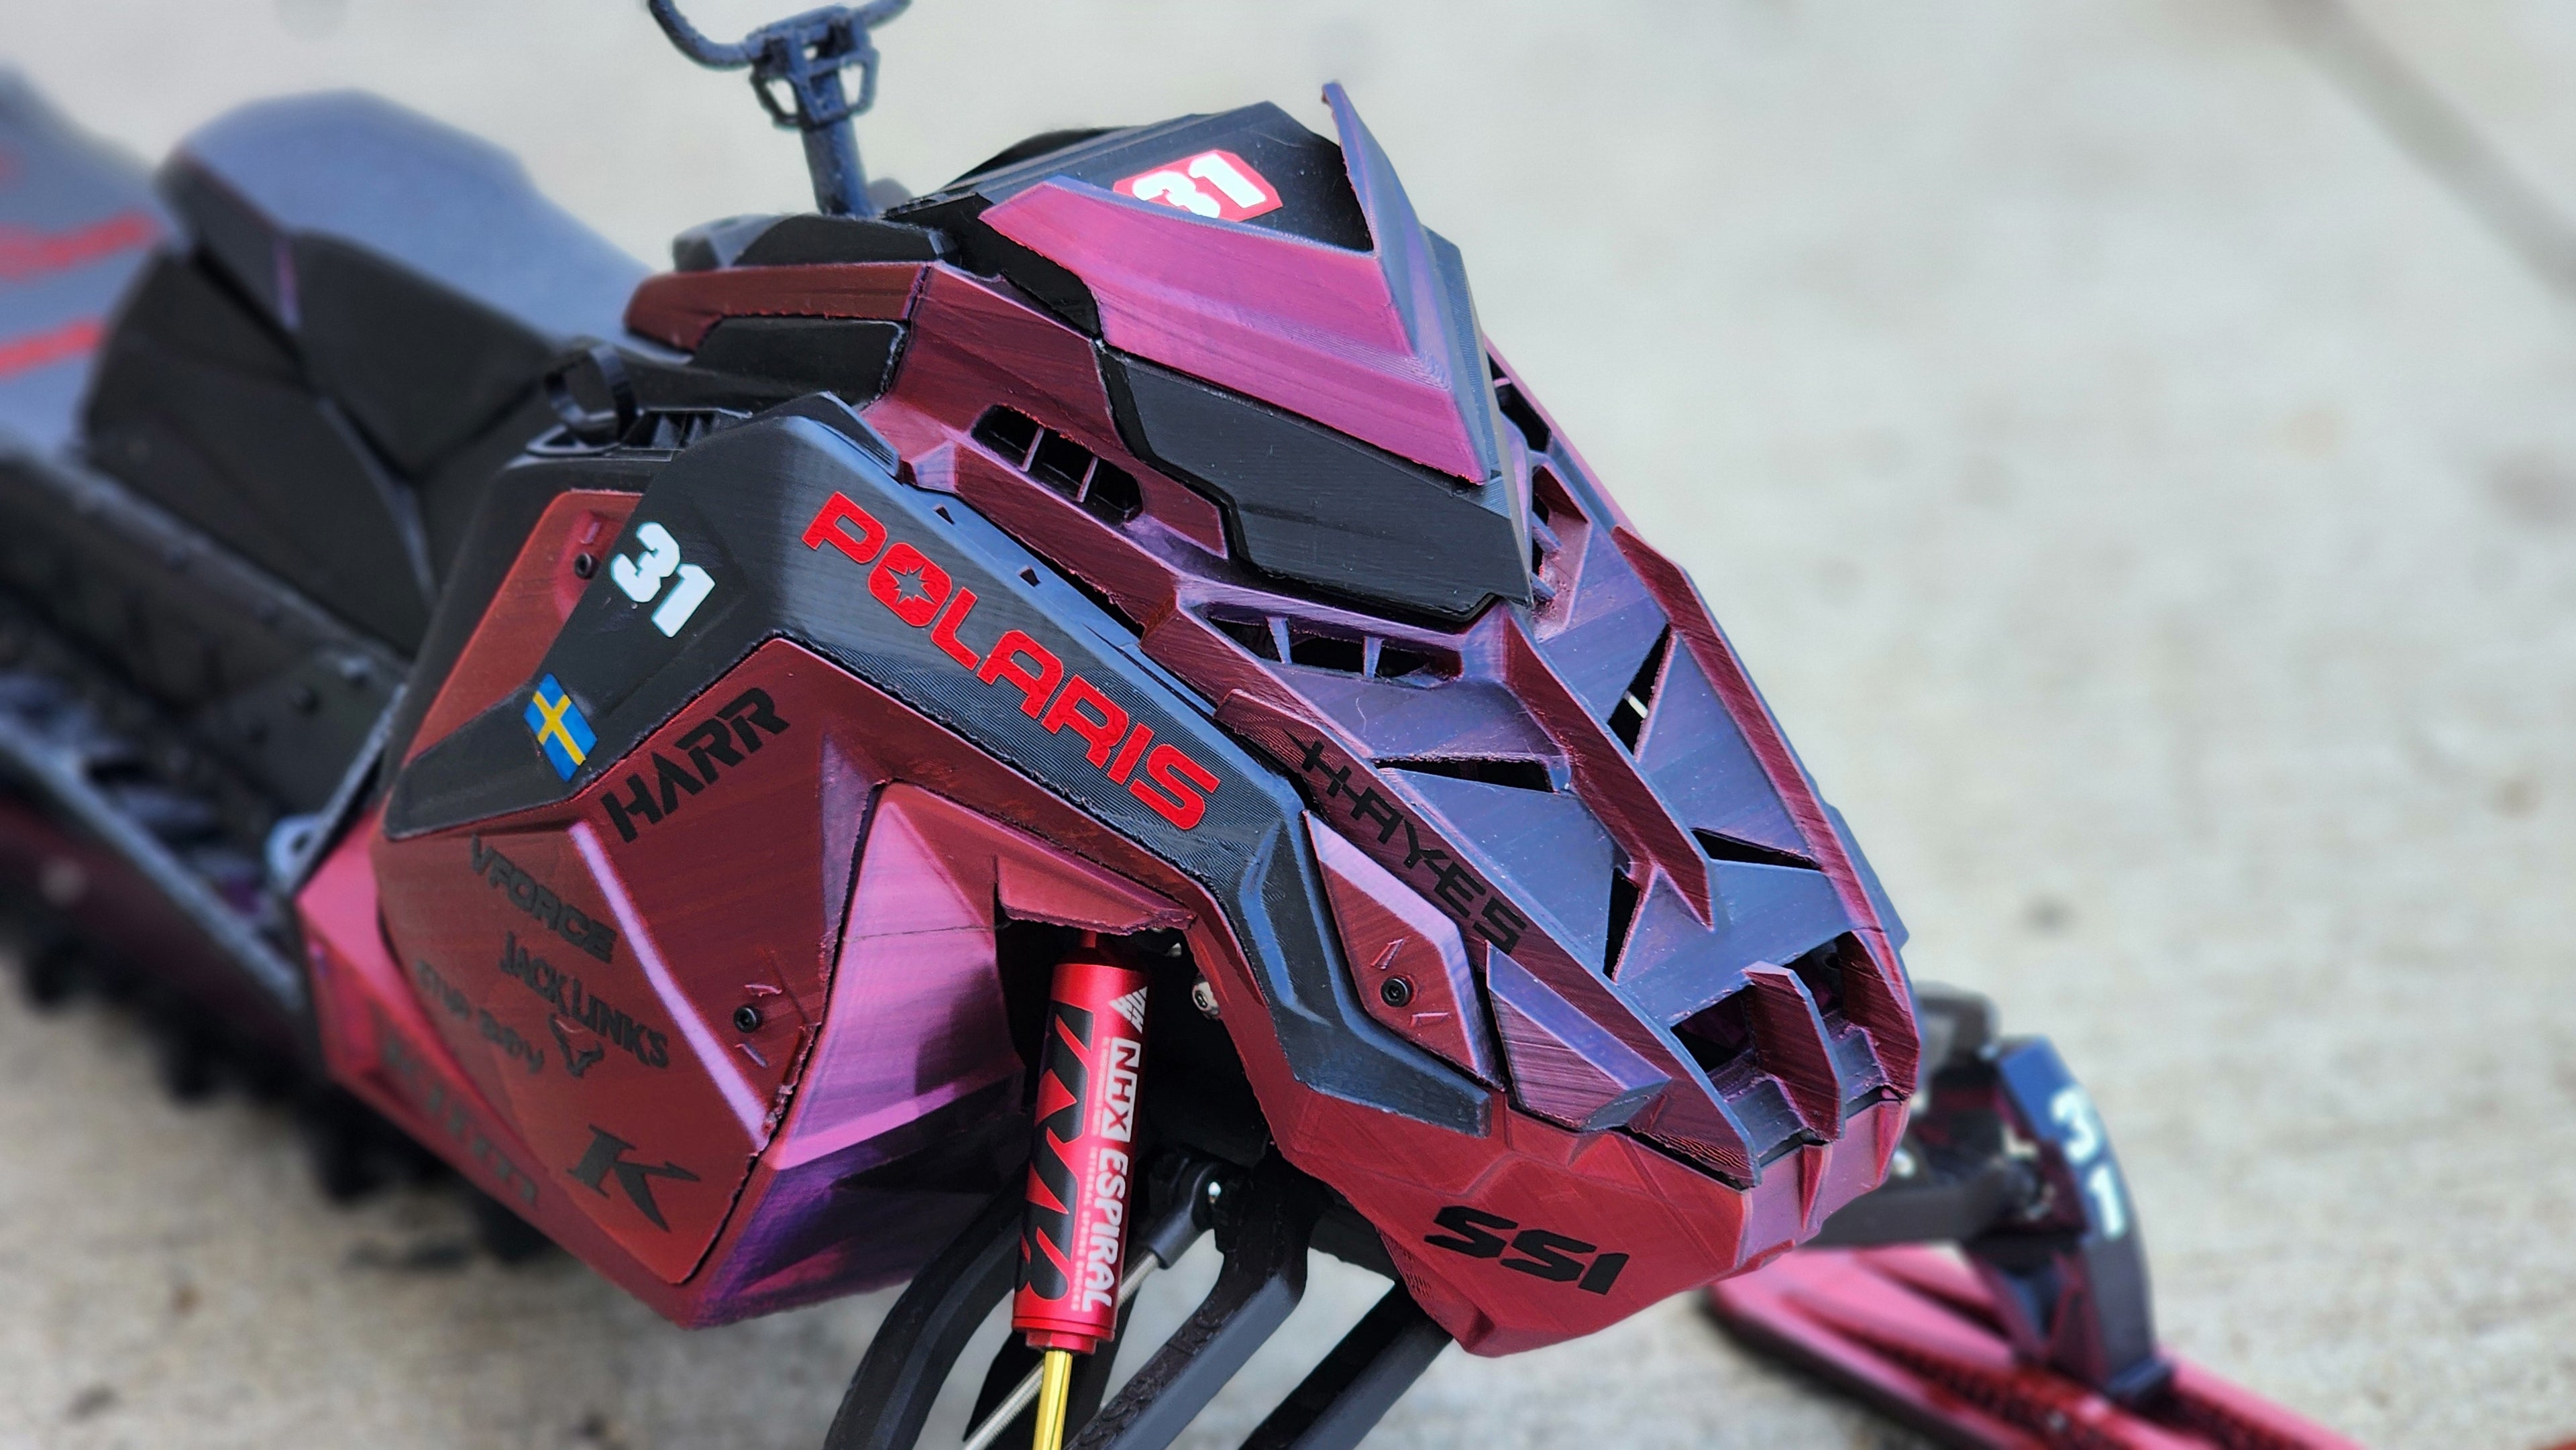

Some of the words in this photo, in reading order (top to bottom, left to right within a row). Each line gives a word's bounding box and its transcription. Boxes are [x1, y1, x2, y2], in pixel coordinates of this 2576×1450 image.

[1132, 153, 1267, 219] 31
[611, 522, 716, 638] 31
[802, 491, 1221, 831] POLARIS
[601, 687, 791, 844] HARR
[472, 834, 617, 964] VFORCE
[1283, 728, 1528, 955] HAYES
[1104, 1041, 1139, 1140] NHX
[566, 1123, 700, 1233] K
[2049, 1084, 2126, 1238] 31
[1081, 1148, 1130, 1313] ESPIRAL
[1424, 1205, 1629, 1296] SSI
